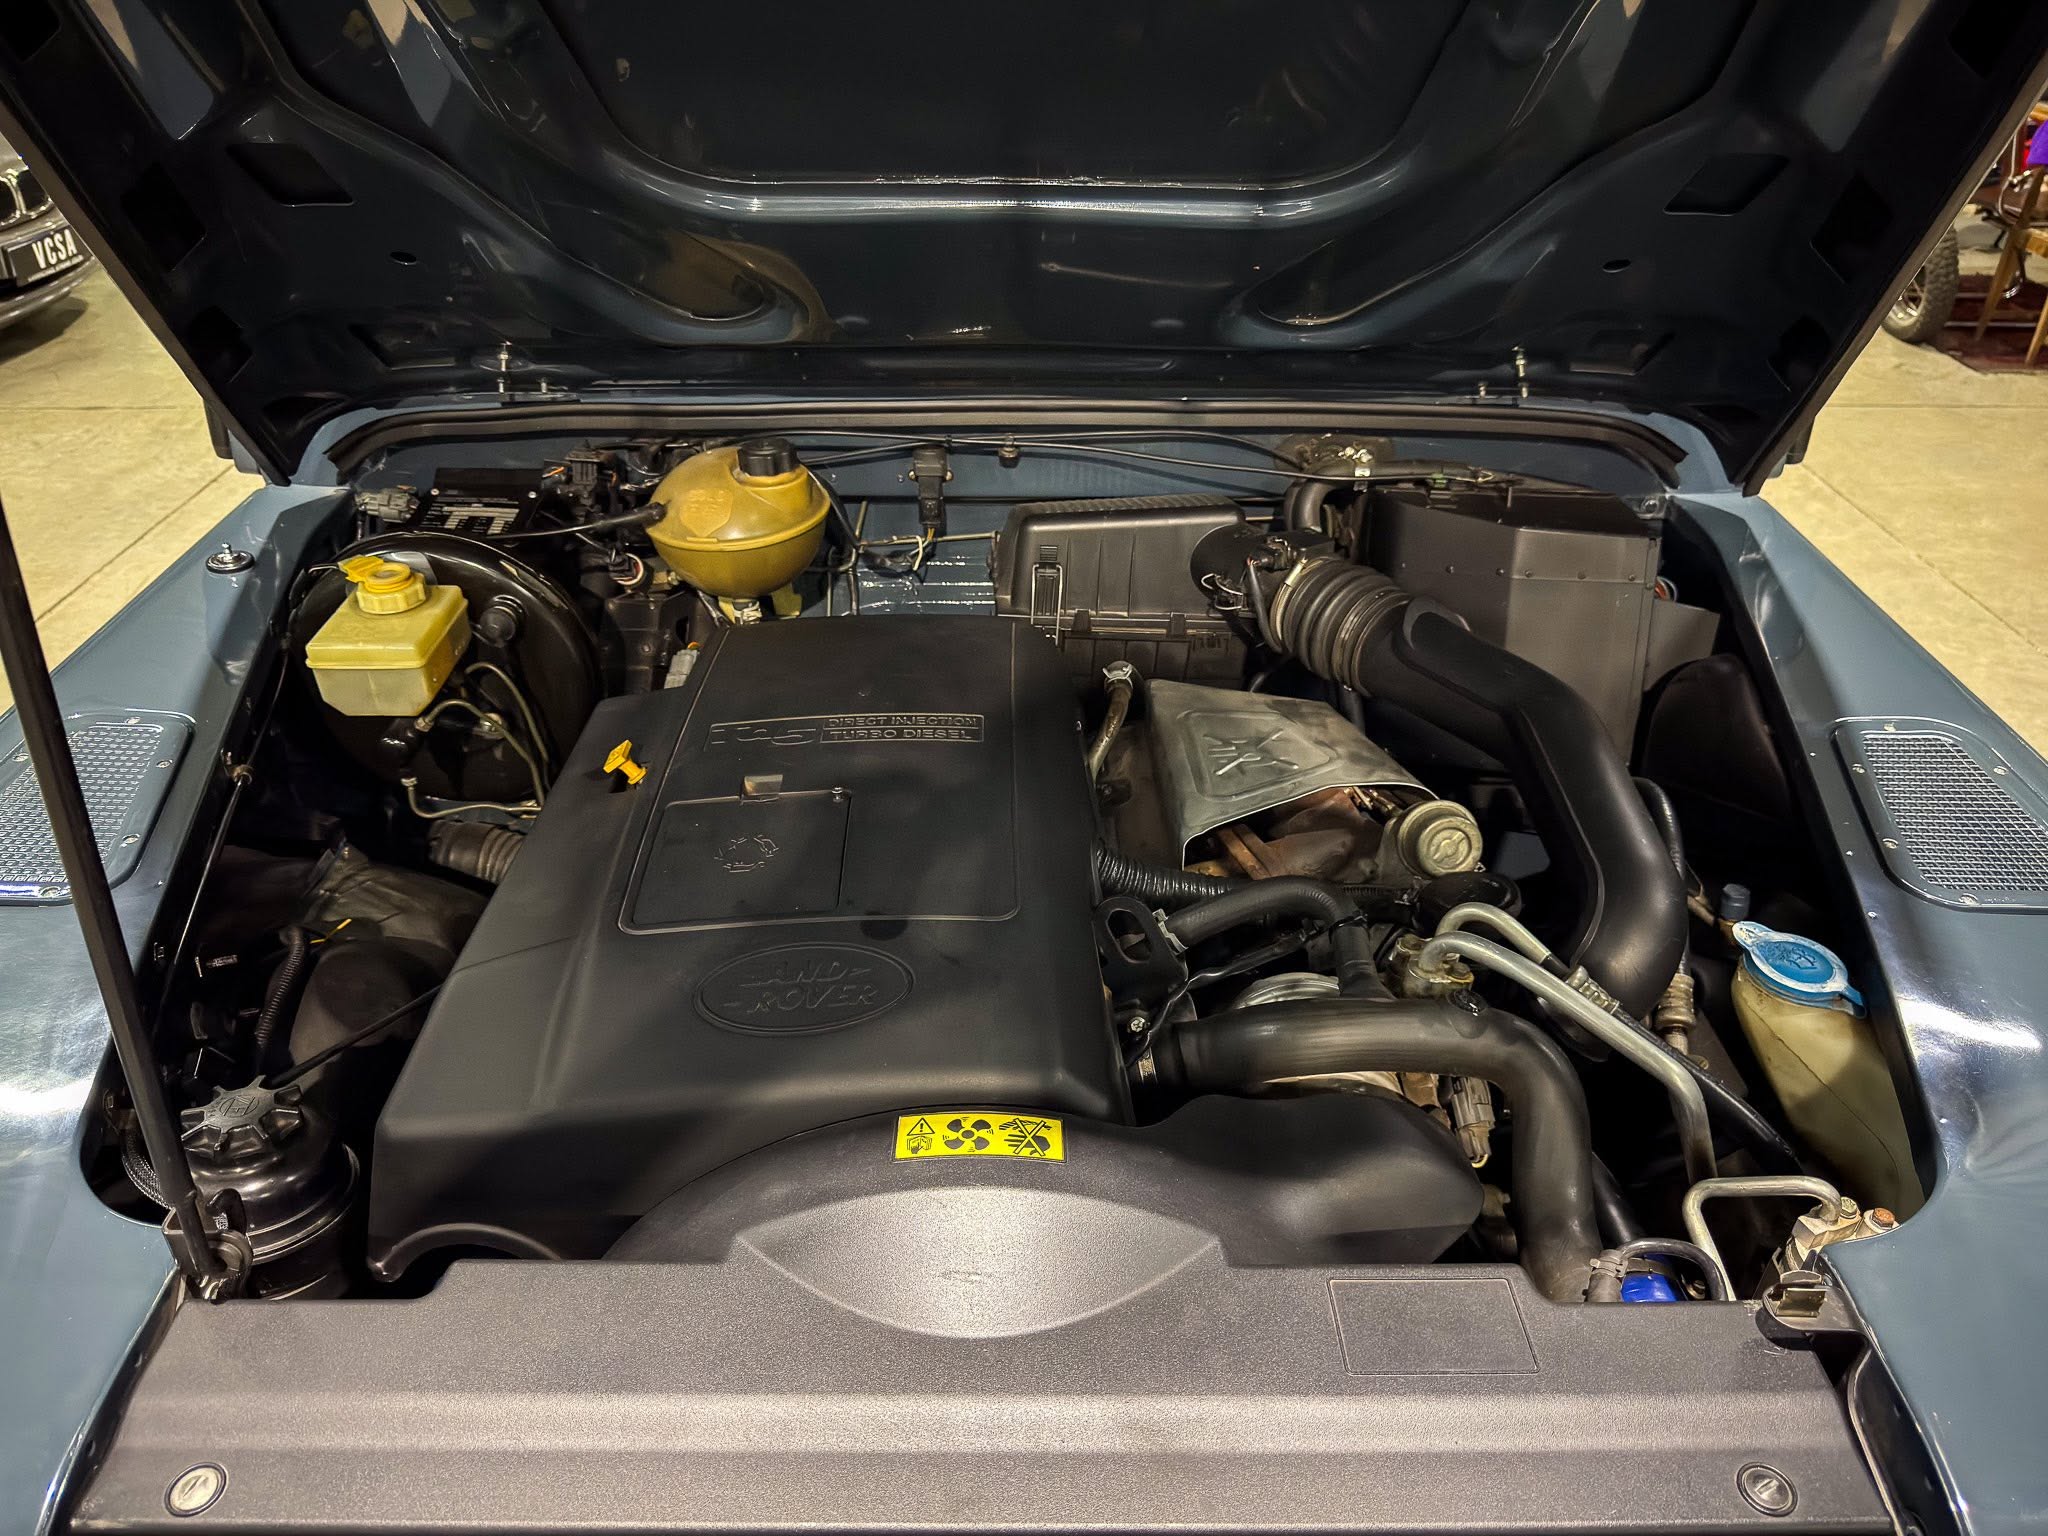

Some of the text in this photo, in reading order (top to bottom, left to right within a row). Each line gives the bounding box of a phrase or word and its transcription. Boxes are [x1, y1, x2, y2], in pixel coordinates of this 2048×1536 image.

[32, 229, 77, 269] VCSA
[828, 715, 978, 727] DIRECT INJECTION
[829, 729, 974, 740] TURBO DIESEL
[747, 984, 879, 1013] ROVER
